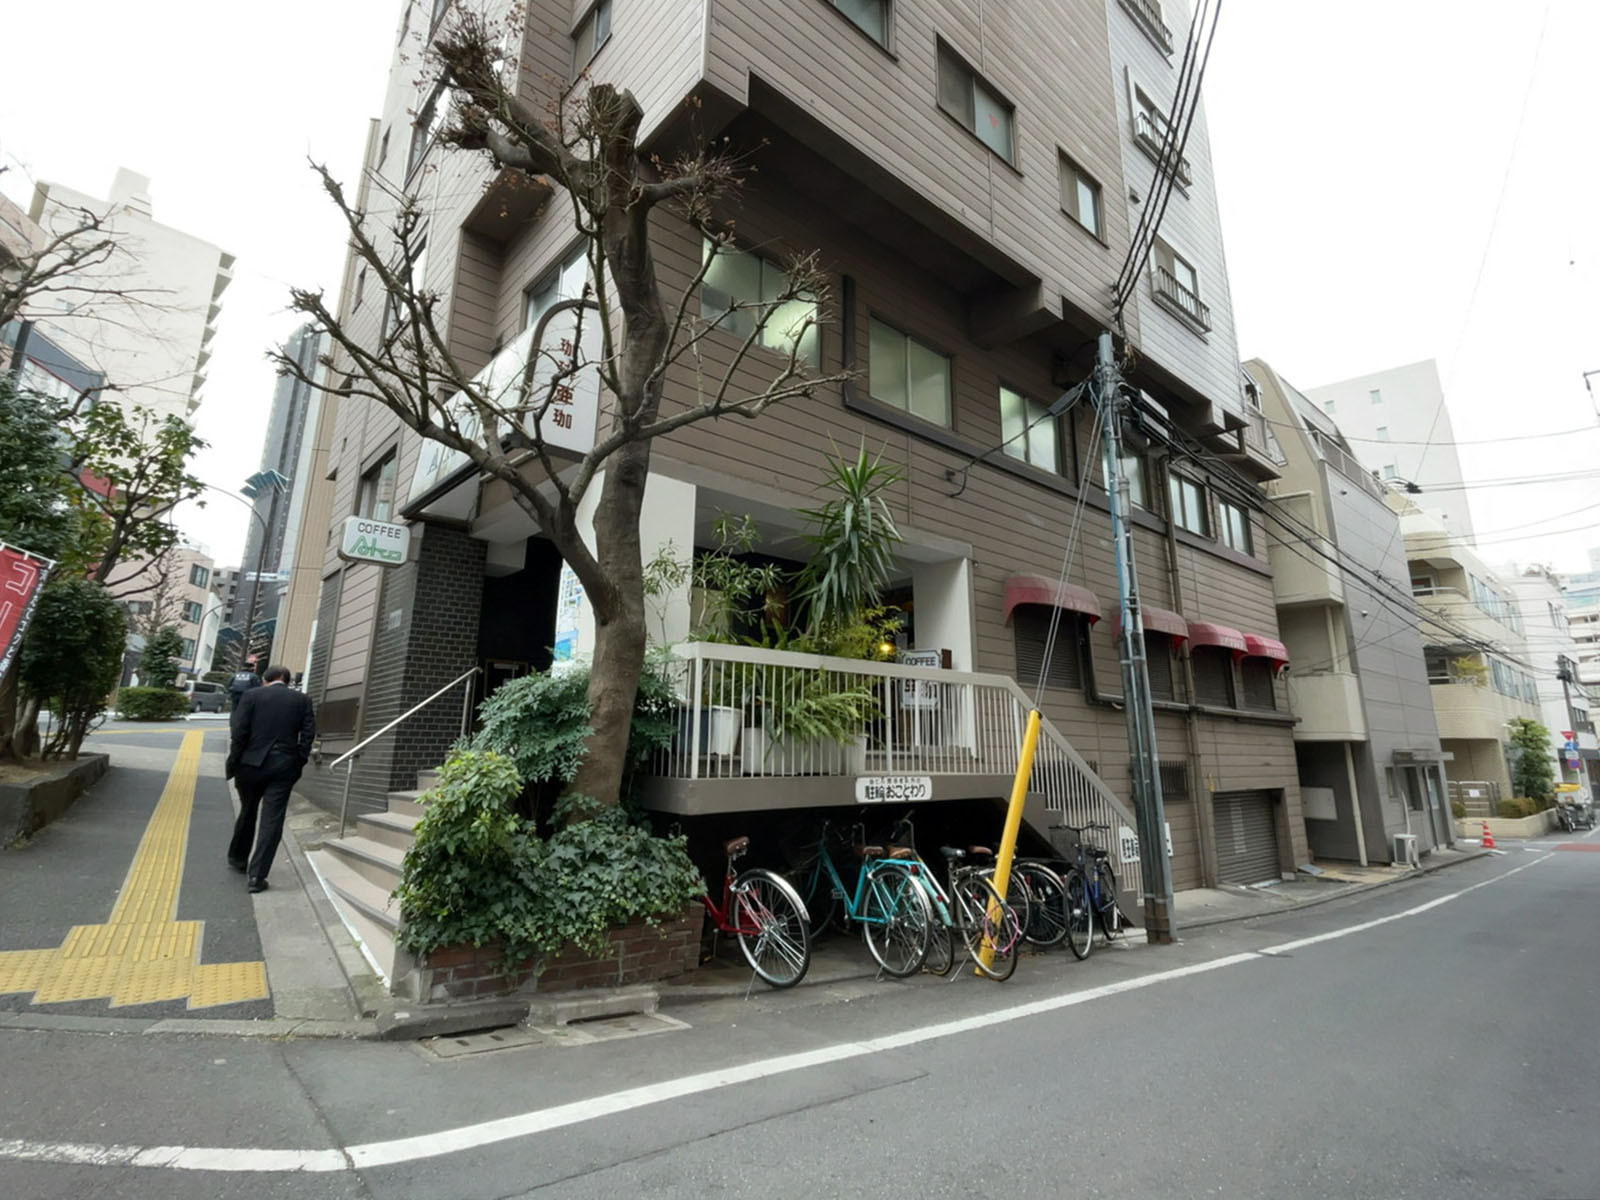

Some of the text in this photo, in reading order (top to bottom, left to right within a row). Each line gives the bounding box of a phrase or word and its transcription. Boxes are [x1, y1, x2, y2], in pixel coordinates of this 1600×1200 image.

[551, 337, 579, 430] 珈亜珈
[357, 522, 401, 539] COFFEE
[905, 656, 937, 667] COFFEE
